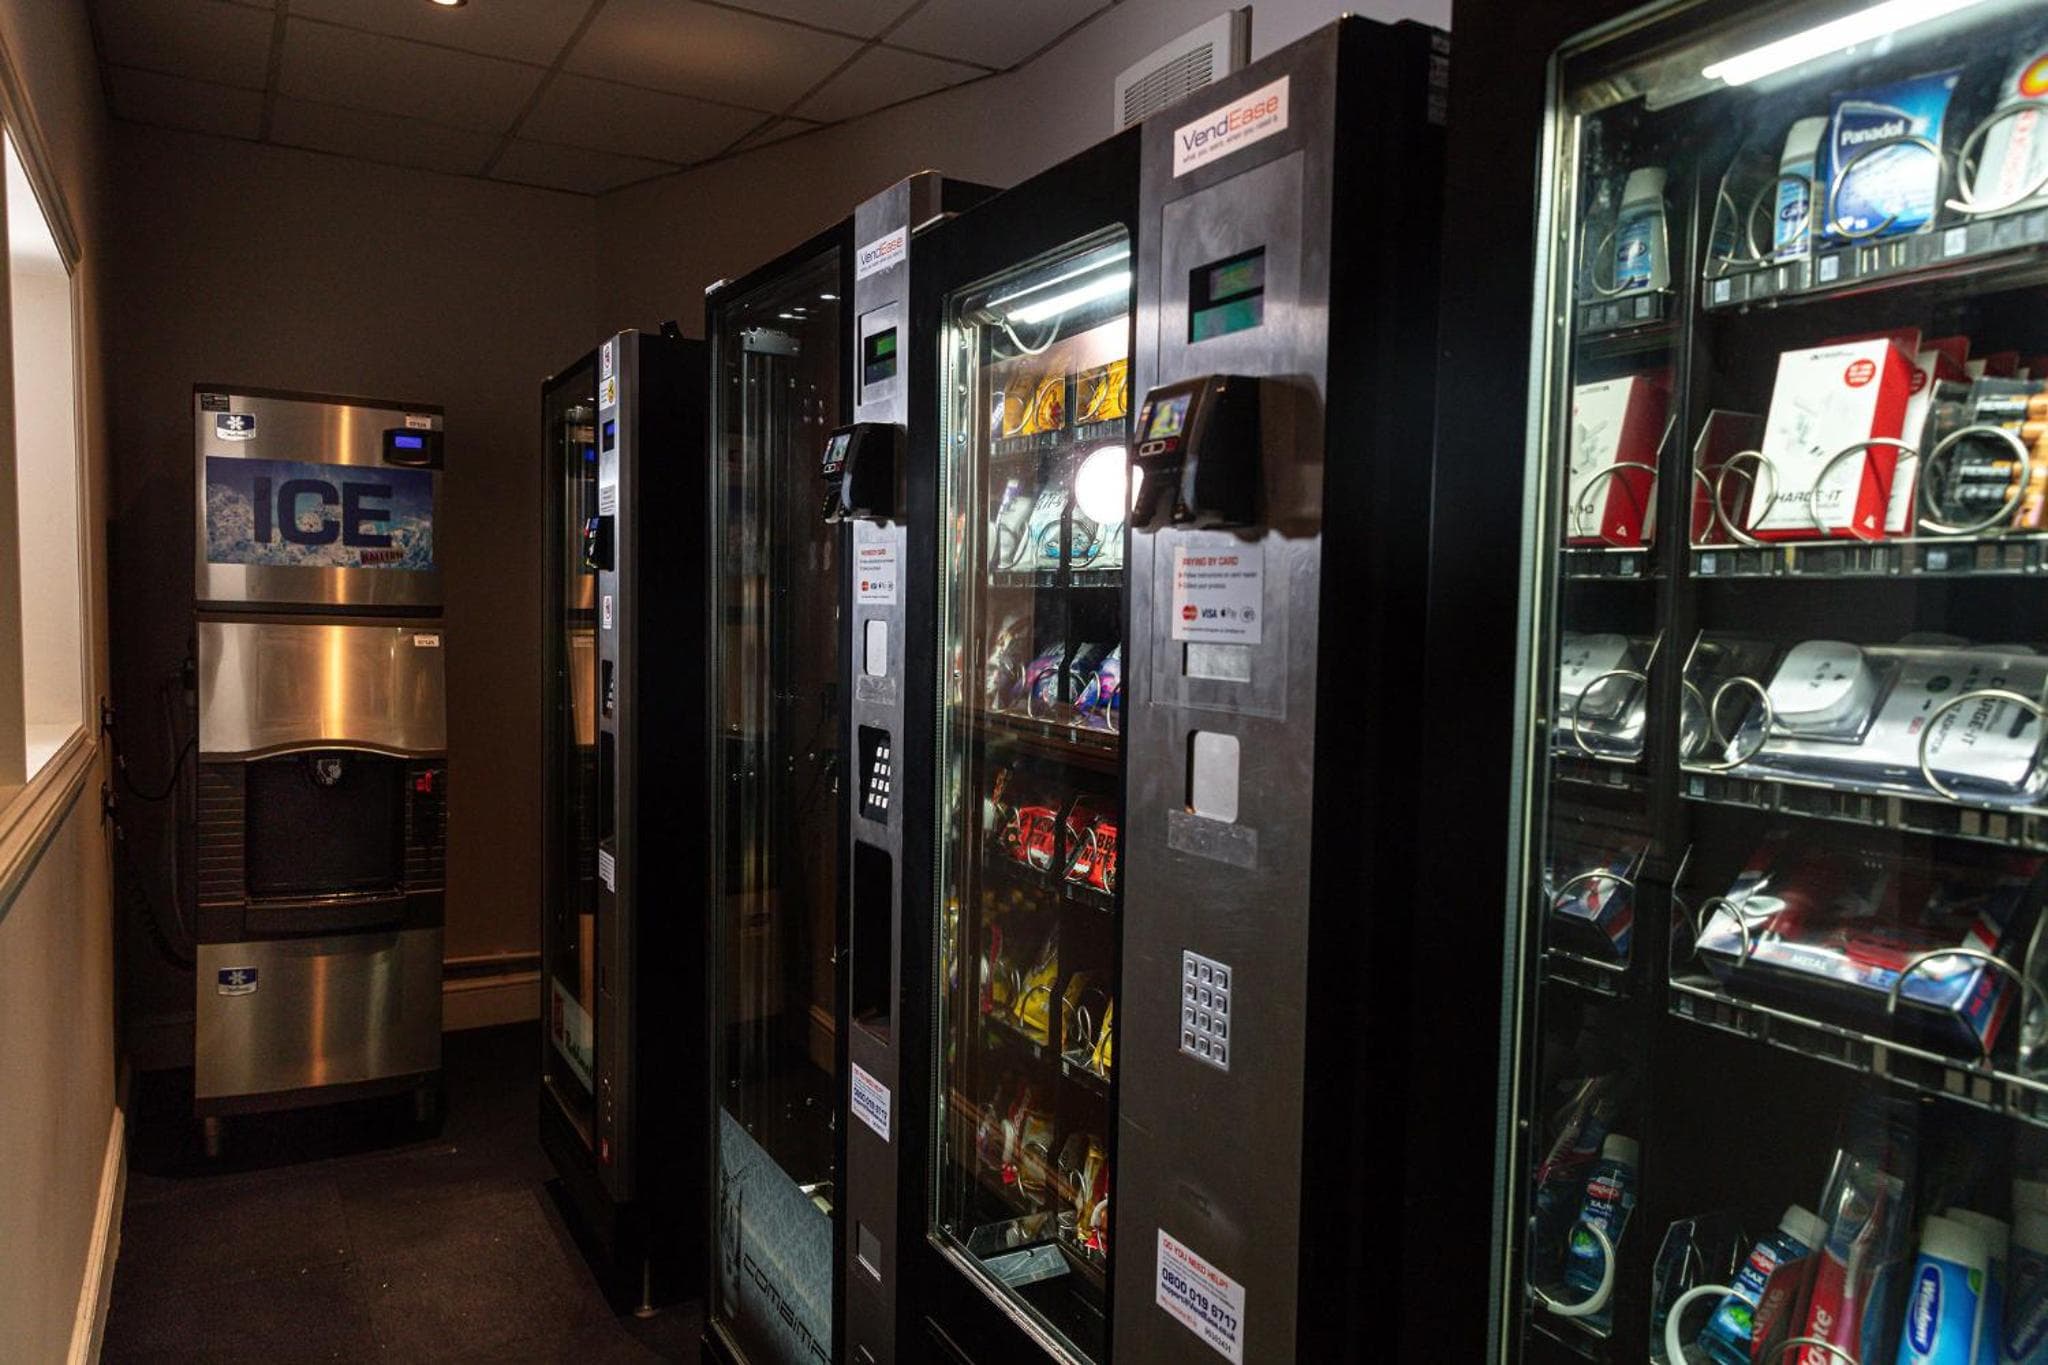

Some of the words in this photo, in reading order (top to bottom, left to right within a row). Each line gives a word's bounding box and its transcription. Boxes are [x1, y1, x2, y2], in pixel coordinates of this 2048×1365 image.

[1183, 96, 1279, 151] VendEase
[1841, 120, 1905, 146] Panadol
[253, 476, 392, 548] ICE
[1202, 608, 1217, 619] VISA
[1163, 1239, 1173, 1251] DO
[1174, 1246, 1188, 1262] YOU
[1188, 1256, 1206, 1275] NEED
[743, 1252, 832, 1365] COMBIMA
[1162, 1267, 1187, 1295] 0800
[1189, 1288, 1208, 1311] 019
